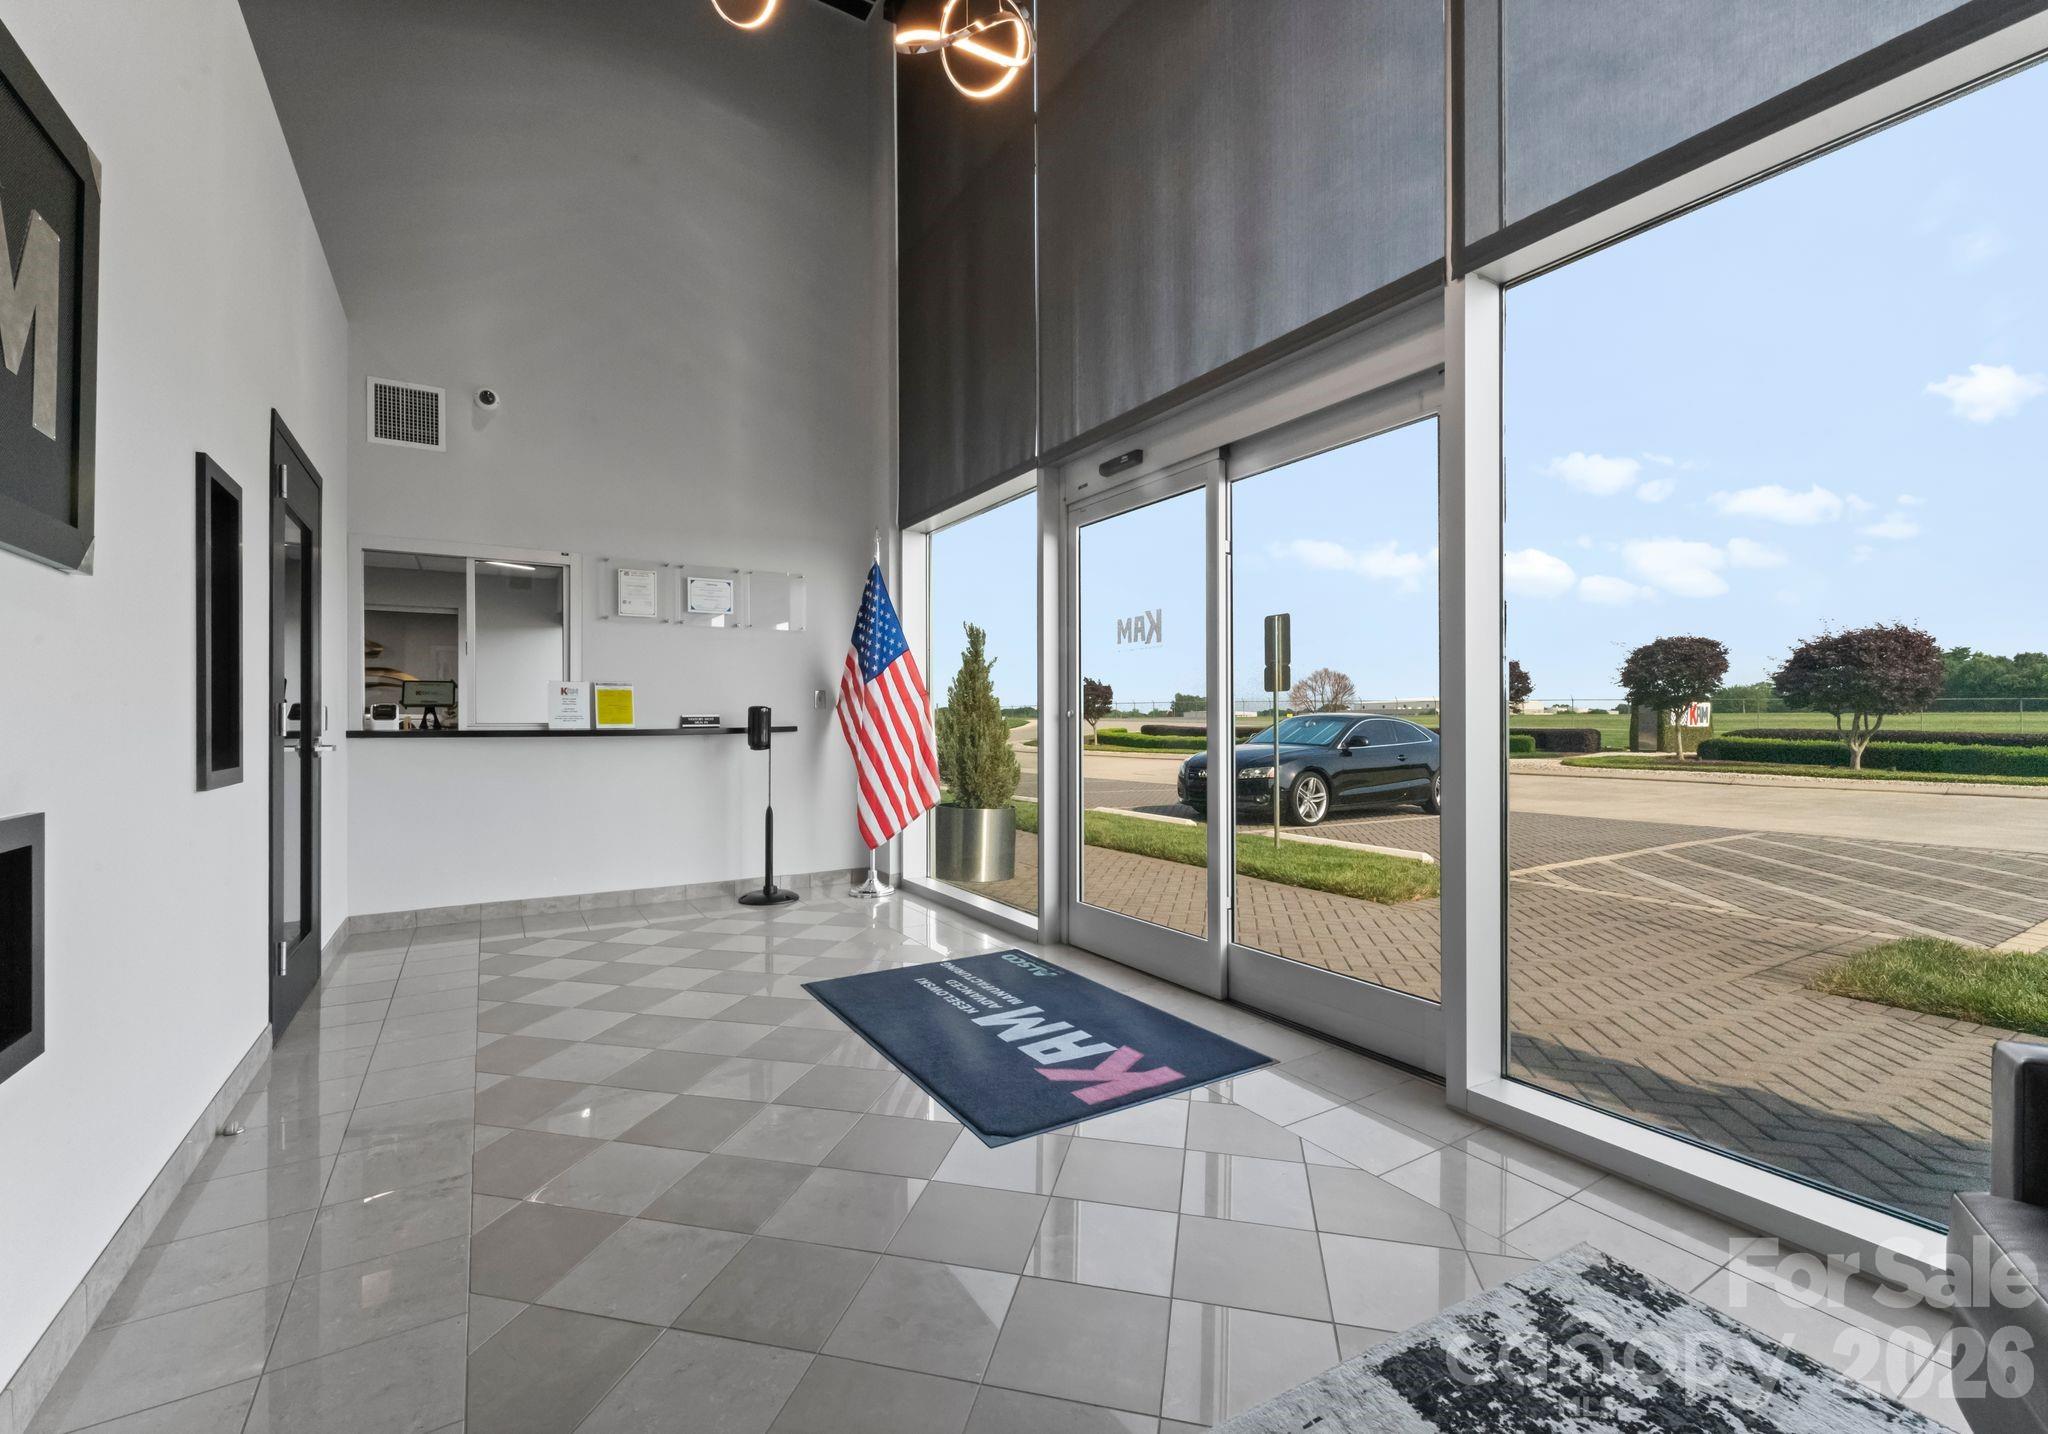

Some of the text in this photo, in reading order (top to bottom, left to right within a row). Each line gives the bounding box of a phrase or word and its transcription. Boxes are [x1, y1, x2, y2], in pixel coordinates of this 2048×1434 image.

[1689, 703, 1709, 726] KAM
[1001, 954, 1058, 977] ALSCO
[914, 977, 979, 1014] KESELOWSKI
[940, 961, 1025, 1005] MANUFACTURING
[945, 979, 1003, 1009] ADVANCED
[971, 1005, 1186, 1105] KAM
